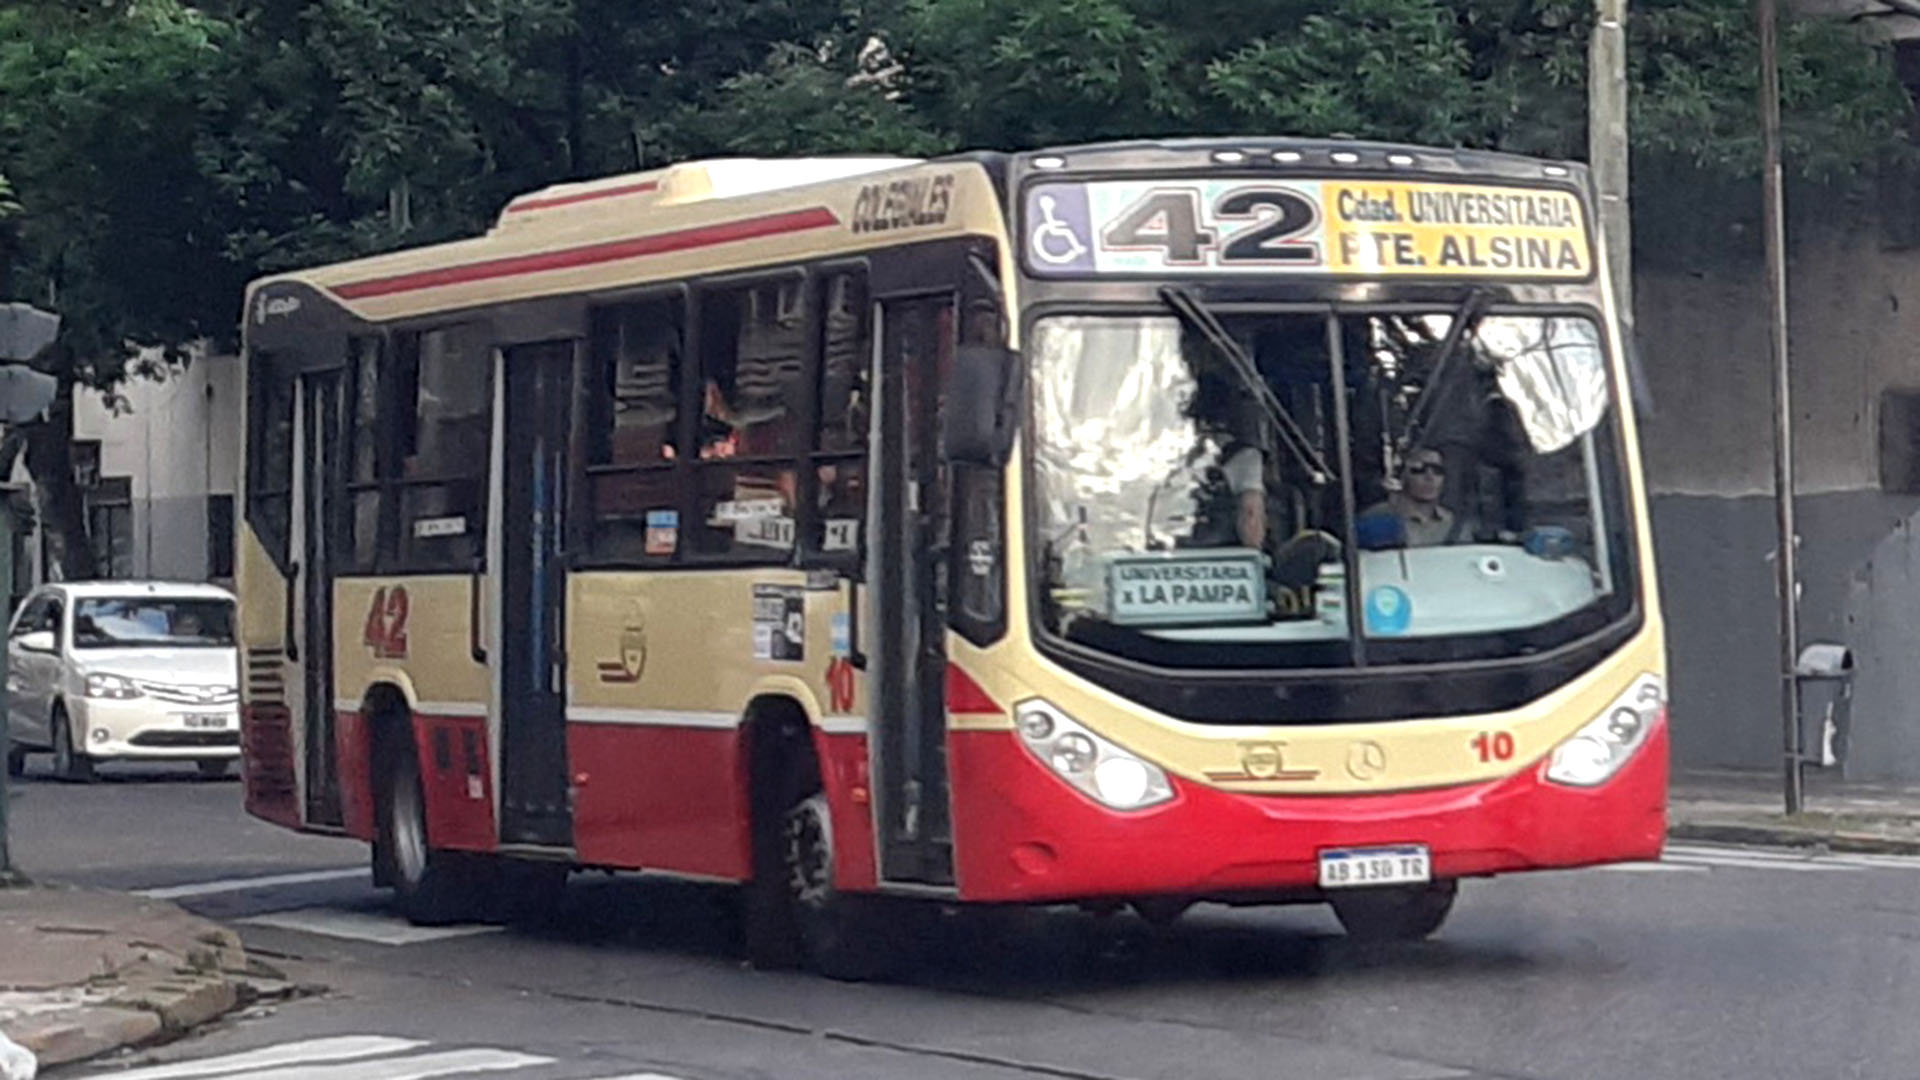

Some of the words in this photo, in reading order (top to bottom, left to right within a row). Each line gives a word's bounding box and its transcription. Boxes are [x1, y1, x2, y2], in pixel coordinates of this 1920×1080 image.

[1101, 185, 1321, 266] 42
[1338, 188, 1402, 222] Cdad.
[1407, 190, 1576, 227] UNIVERSITARIA
[1440, 234, 1582, 270] ALSINA
[1120, 566, 1252, 581] UNIVERSITARIA
[1140, 585, 1169, 605] LA
[1172, 584, 1252, 605] PAMPA
[364, 585, 409, 660] 42
[826, 656, 855, 712] 10
[1470, 731, 1515, 763] 10
